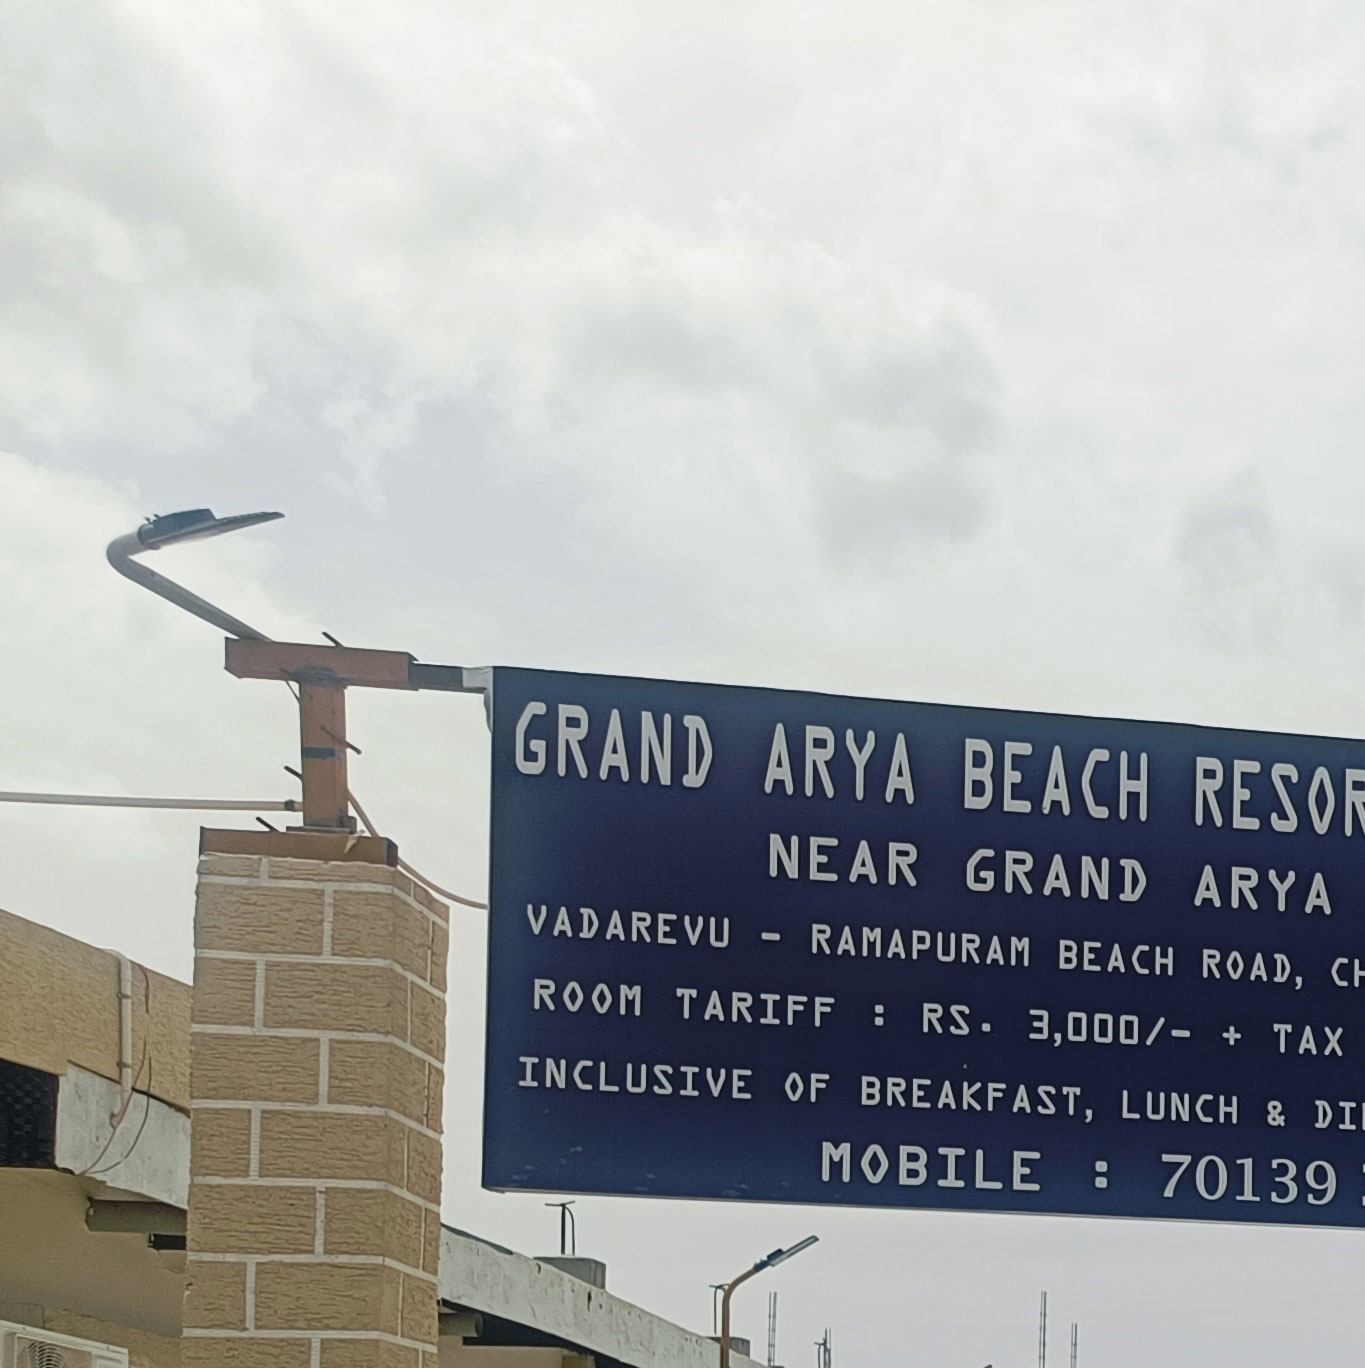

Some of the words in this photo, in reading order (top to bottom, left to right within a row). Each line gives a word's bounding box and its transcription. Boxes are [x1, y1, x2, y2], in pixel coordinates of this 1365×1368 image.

[516, 702, 712, 787] GRAND
[765, 723, 914, 804] ARYA
[965, 738, 1147, 821] BEACH
[770, 834, 917, 886] NEAR
[967, 849, 1146, 901] GRAND
[1195, 865, 1331, 914] ARYA
[527, 904, 728, 947] VADAREVU
[812, 924, 1029, 966] RAMAPURAM
[1060, 940, 1173, 975] BEACH
[1203, 949, 1302, 989] ROAD,
[534, 979, 640, 1016] ROOM
[677, 988, 834, 1026] TARIFF
[923, 1003, 990, 1035] RS.
[1030, 1010, 1190, 1046] 3,000/-
[1274, 1024, 1342, 1056] TAX
[519, 1057, 751, 1099] INCLUSIVE
[785, 1073, 829, 1102] OF
[862, 1076, 1092, 1122] BREAKFAST,
[1123, 1090, 1237, 1123] LUNCH
[822, 1142, 1040, 1190] MOBILE
[1162, 1154, 1336, 1204] 70139
